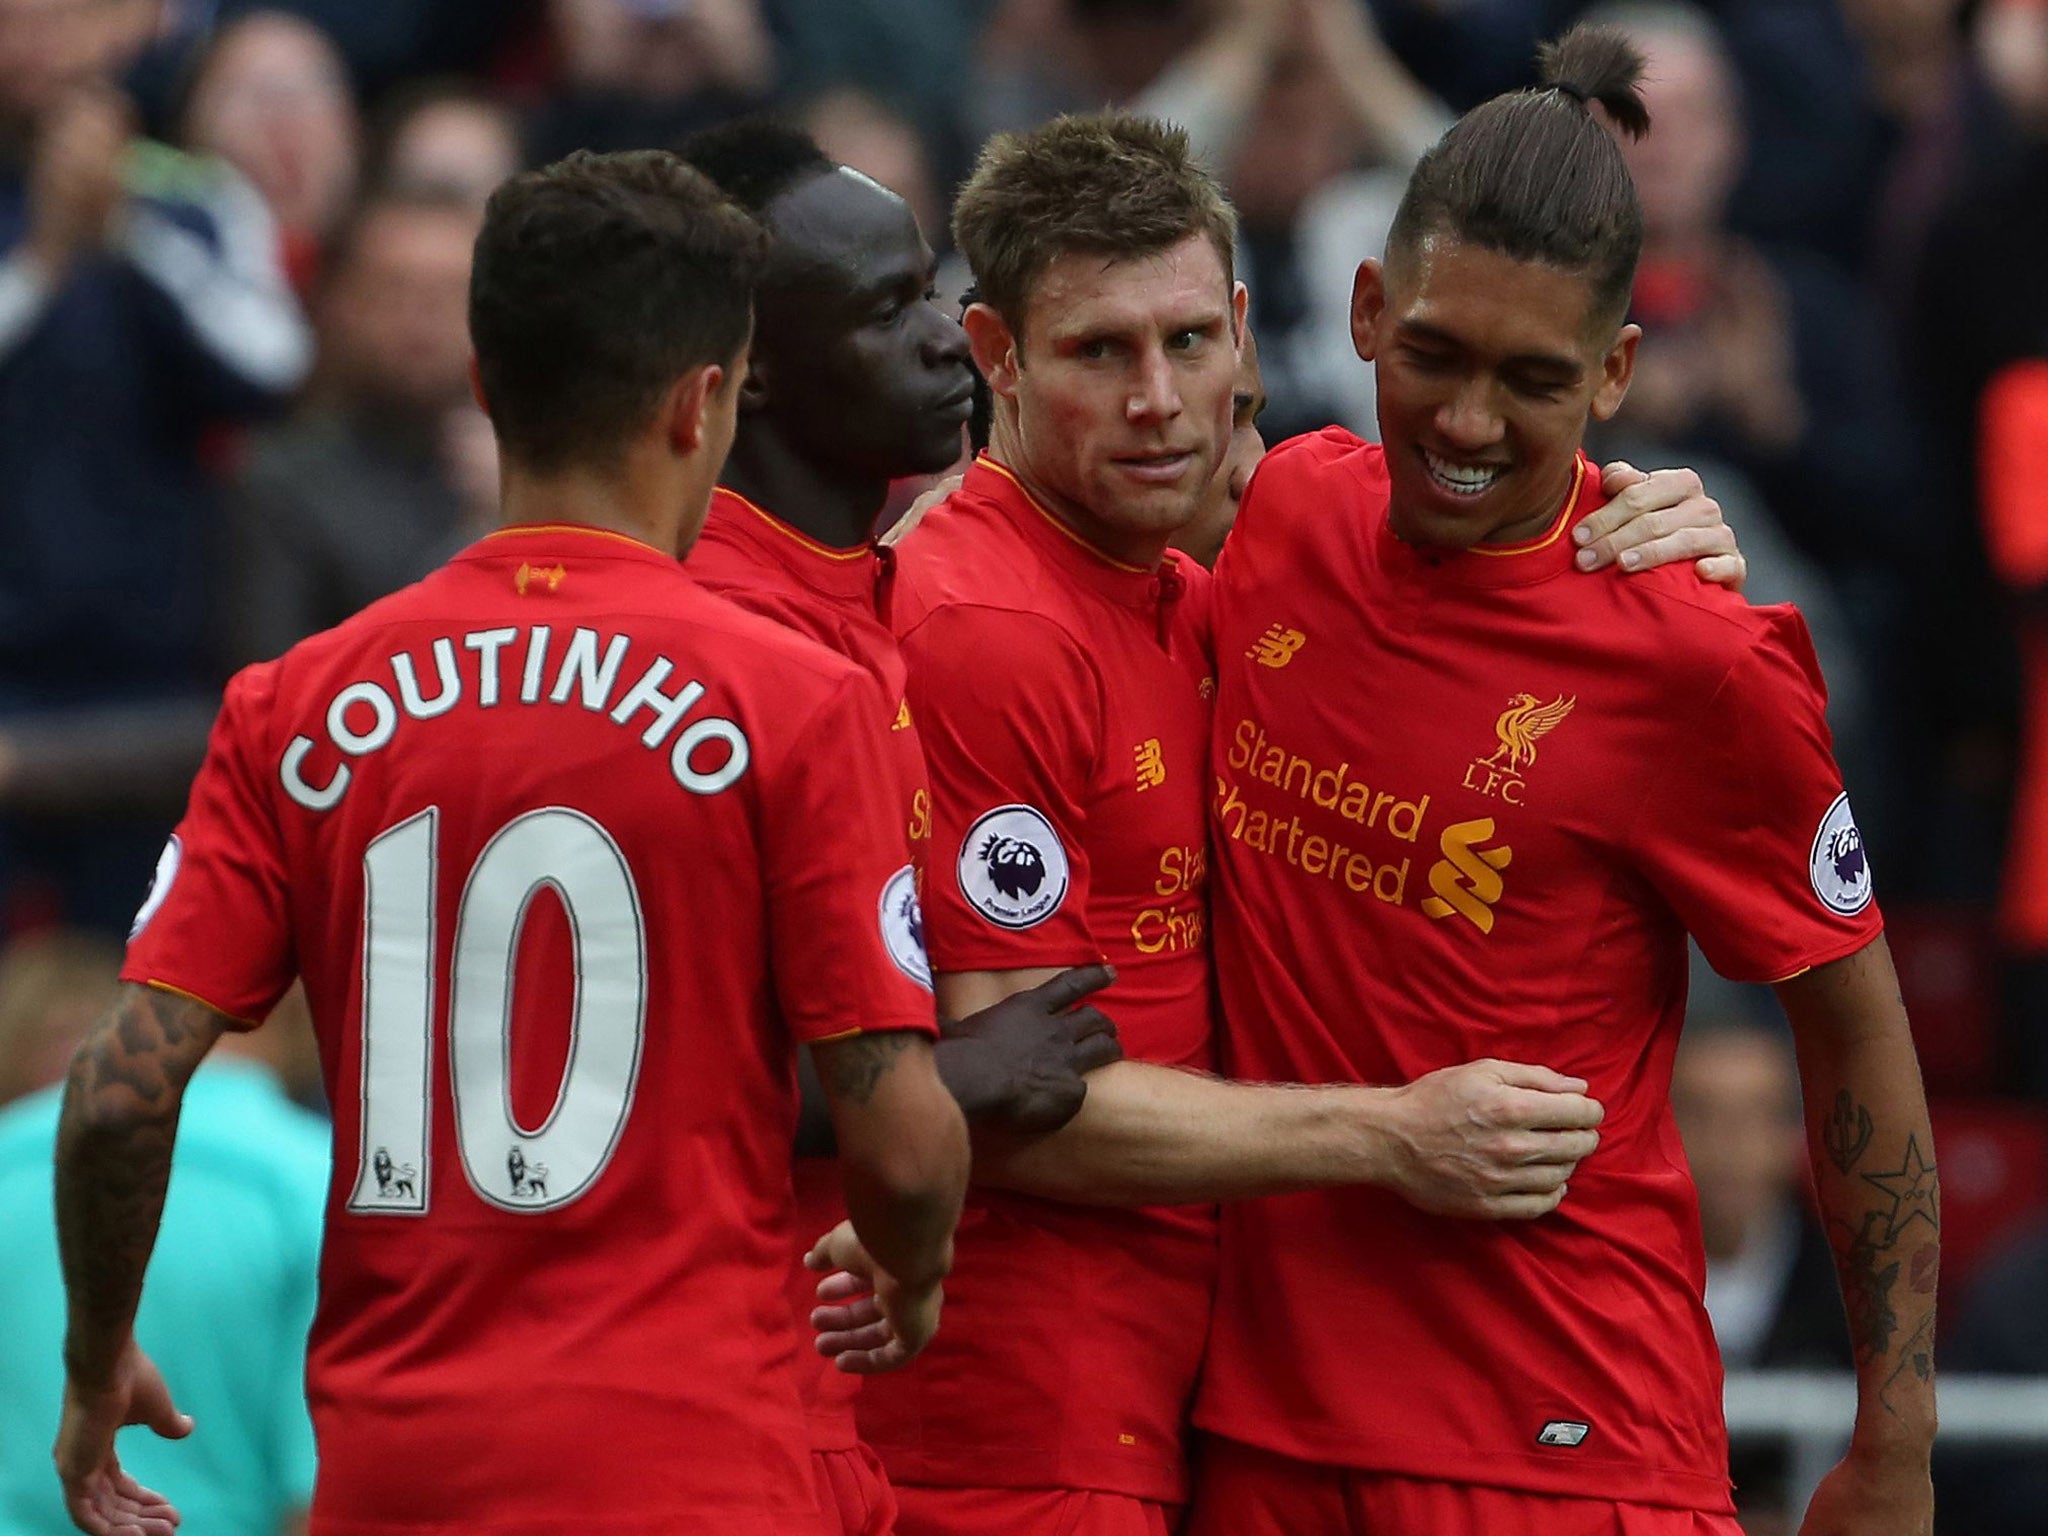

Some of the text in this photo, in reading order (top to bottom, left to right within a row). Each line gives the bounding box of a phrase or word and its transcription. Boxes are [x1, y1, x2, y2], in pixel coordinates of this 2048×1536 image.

[279, 625, 750, 811] COUTINHO
[1228, 719, 1431, 843] Standard
[1214, 775, 1411, 907] hartered
[346, 805, 648, 1216] 10
